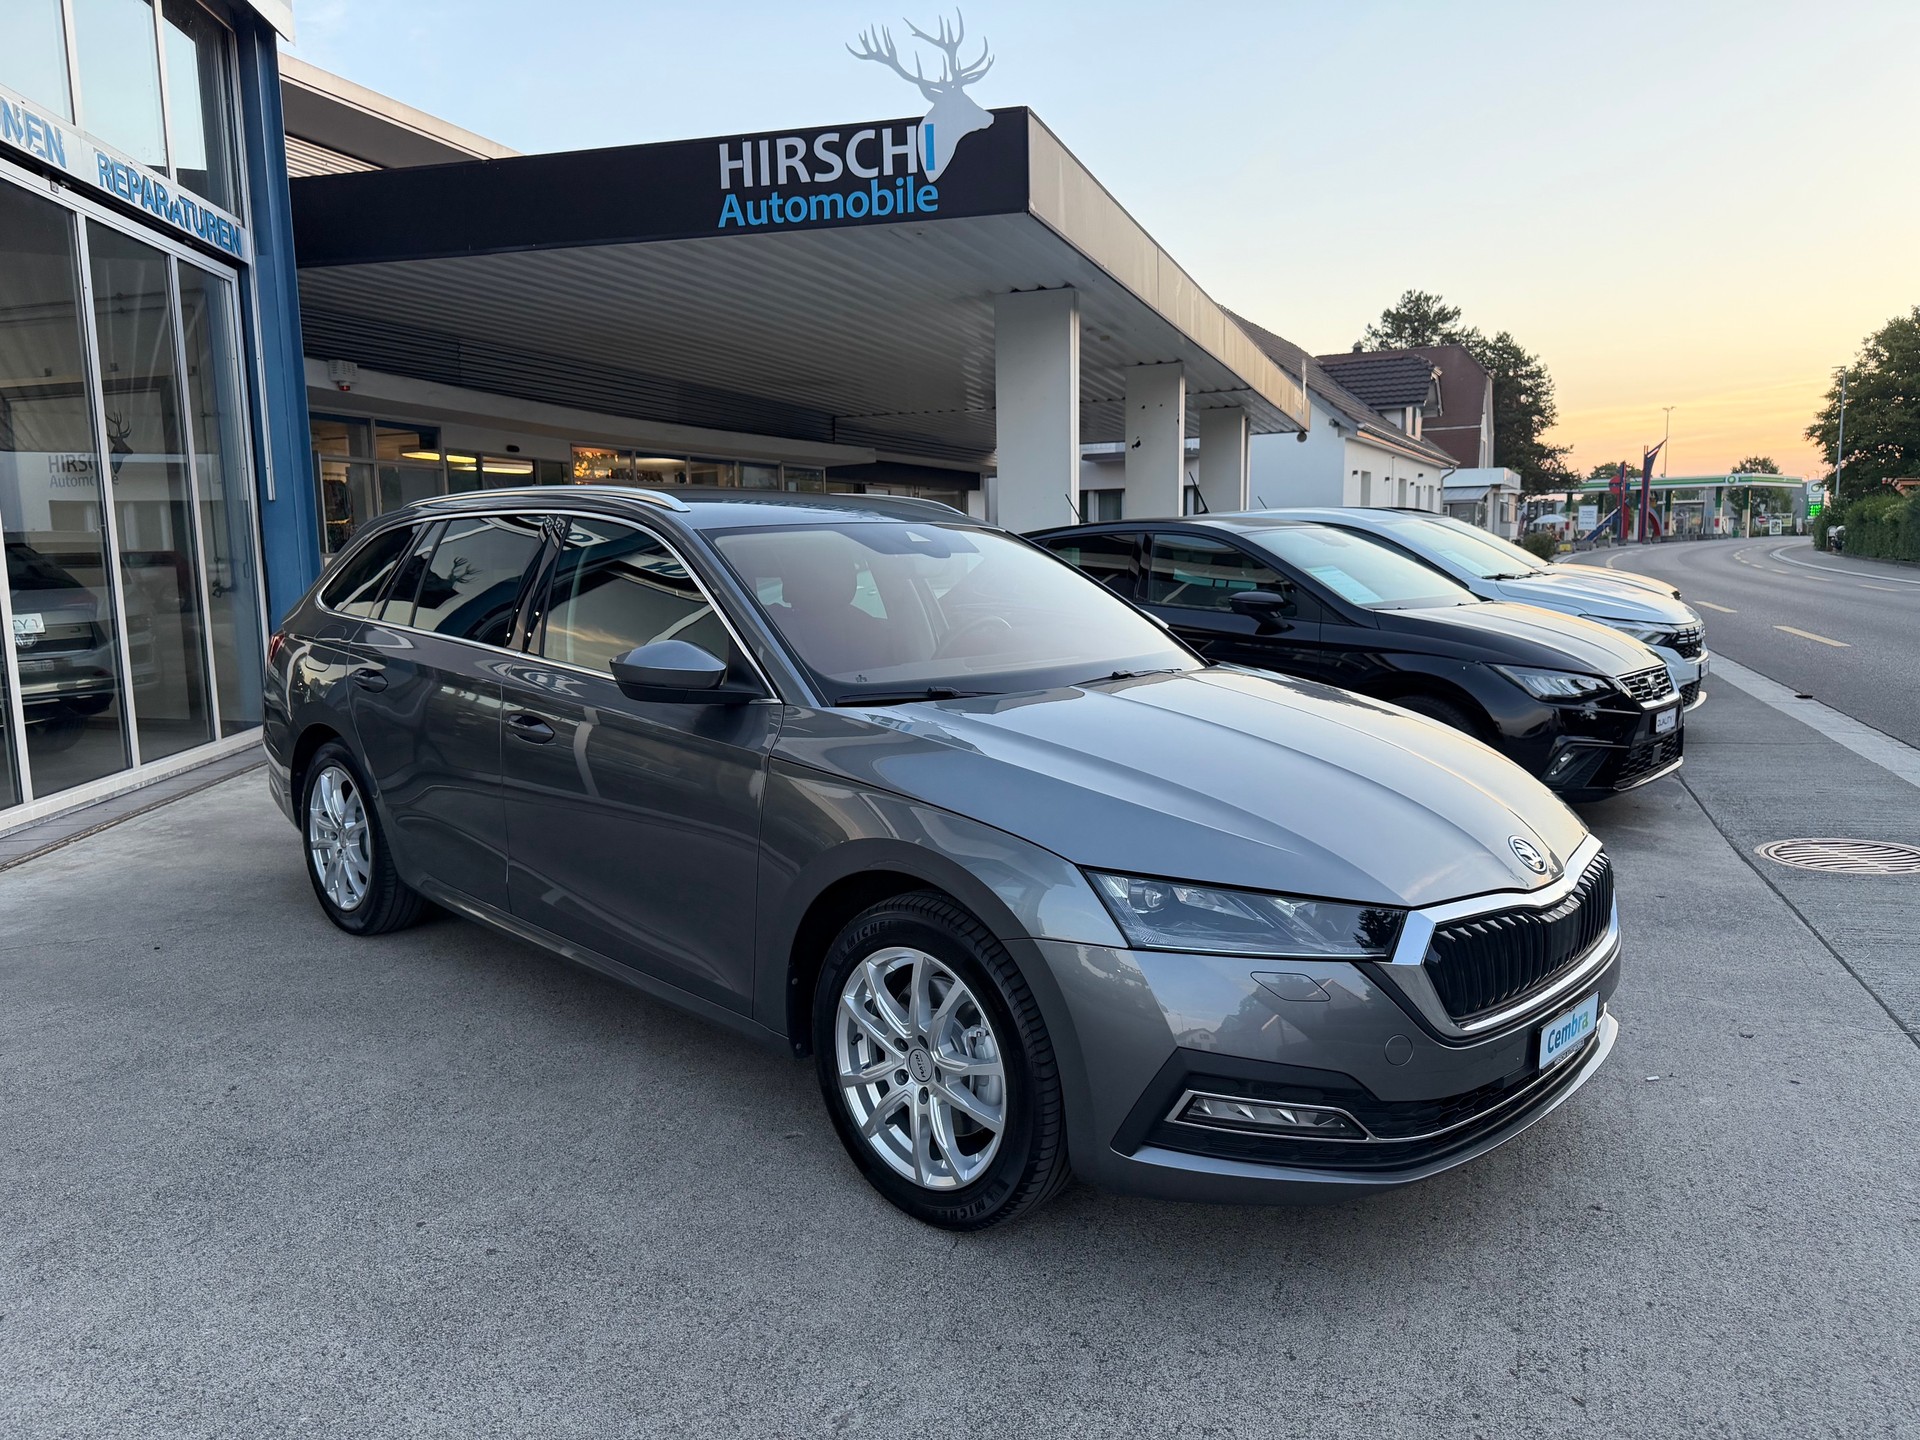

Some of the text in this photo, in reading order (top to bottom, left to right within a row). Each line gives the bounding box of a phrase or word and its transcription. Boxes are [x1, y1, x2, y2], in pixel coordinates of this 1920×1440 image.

[96, 151, 243, 258] REPARATUREN
[717, 175, 939, 228] Automobile
[1547, 1010, 1589, 1054] Cembra
